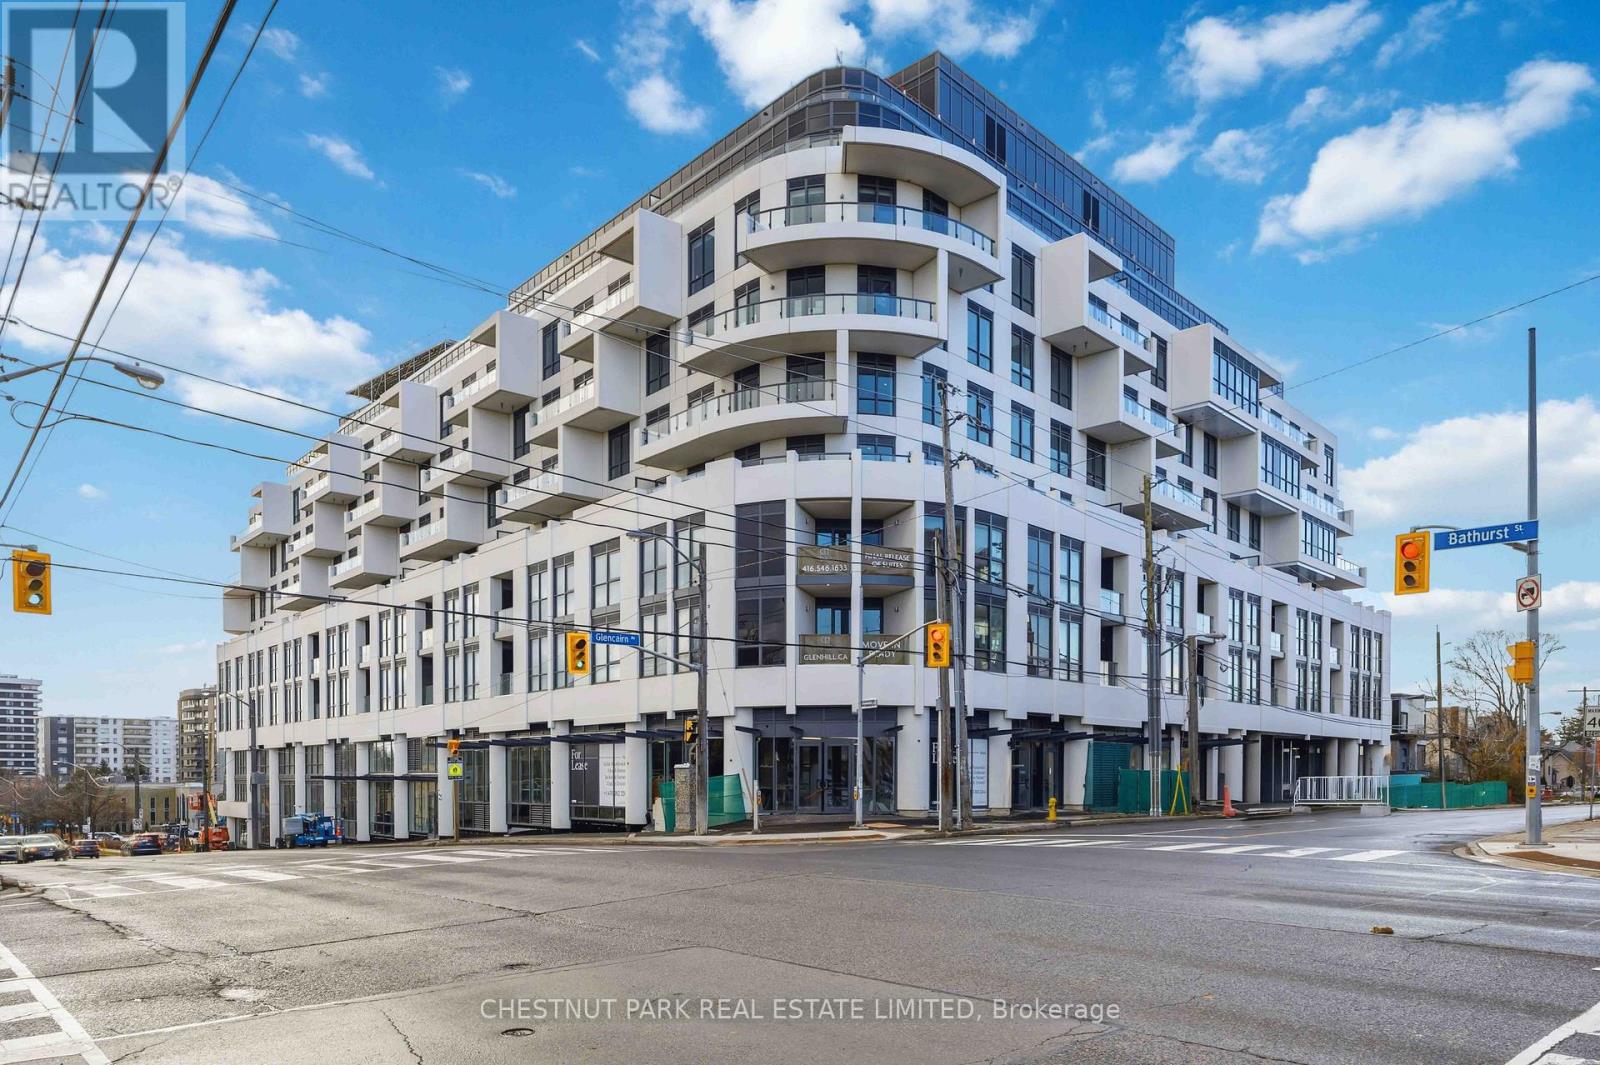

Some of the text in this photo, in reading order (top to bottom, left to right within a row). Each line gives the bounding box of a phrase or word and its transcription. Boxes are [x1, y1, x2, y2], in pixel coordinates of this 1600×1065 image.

[1447, 526, 1510, 546] Bathurst
[595, 632, 629, 643] Glencairn
[571, 748, 582, 760] For
[571, 759, 588, 771] Lease
